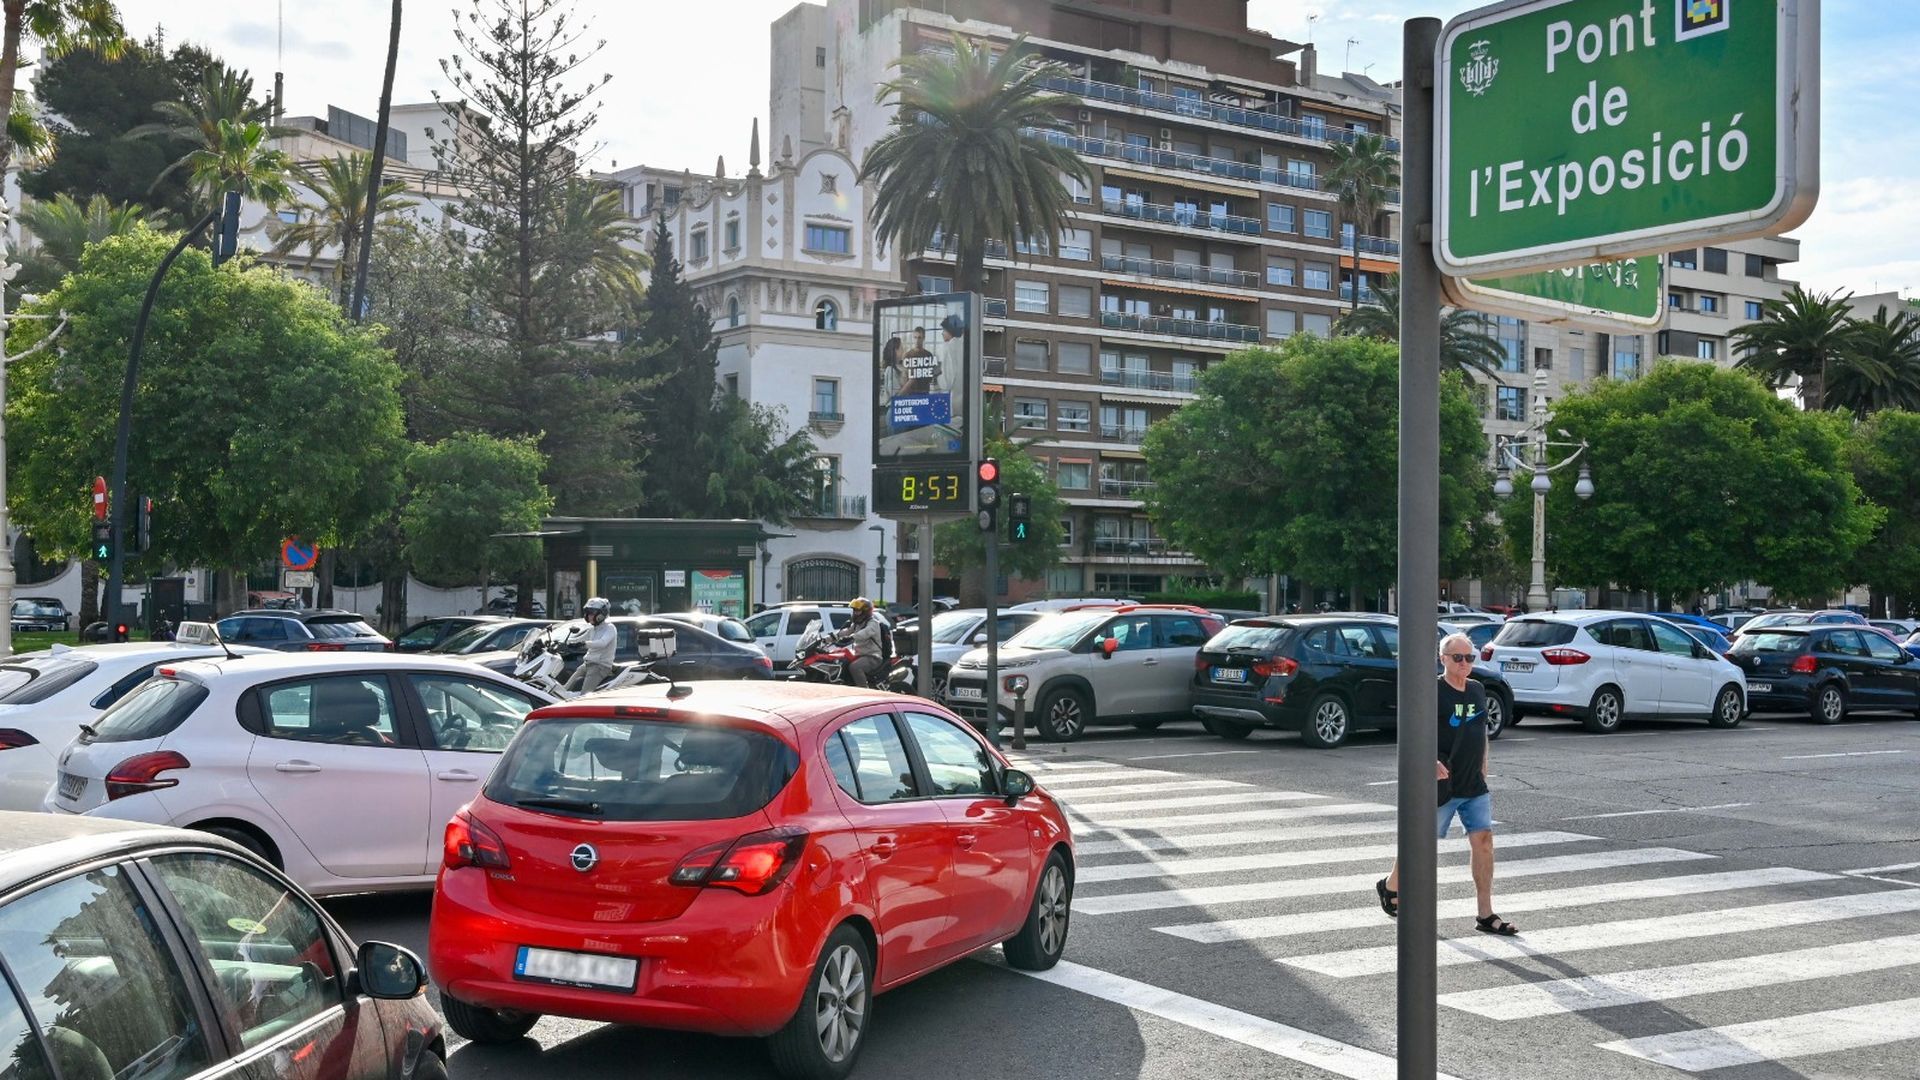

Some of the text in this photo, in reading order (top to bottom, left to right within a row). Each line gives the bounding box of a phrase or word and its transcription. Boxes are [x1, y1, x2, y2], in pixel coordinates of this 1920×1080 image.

[1547, 0, 1656, 73] Pont
[1572, 80, 1627, 134] de
[1469, 113, 1748, 217] l'Exposició
[903, 356, 938, 367] CIENCIA
[908, 367, 934, 379] LIBRE
[894, 398, 929, 407] PROTEGEMOS
[902, 475, 958, 501] 8:53
